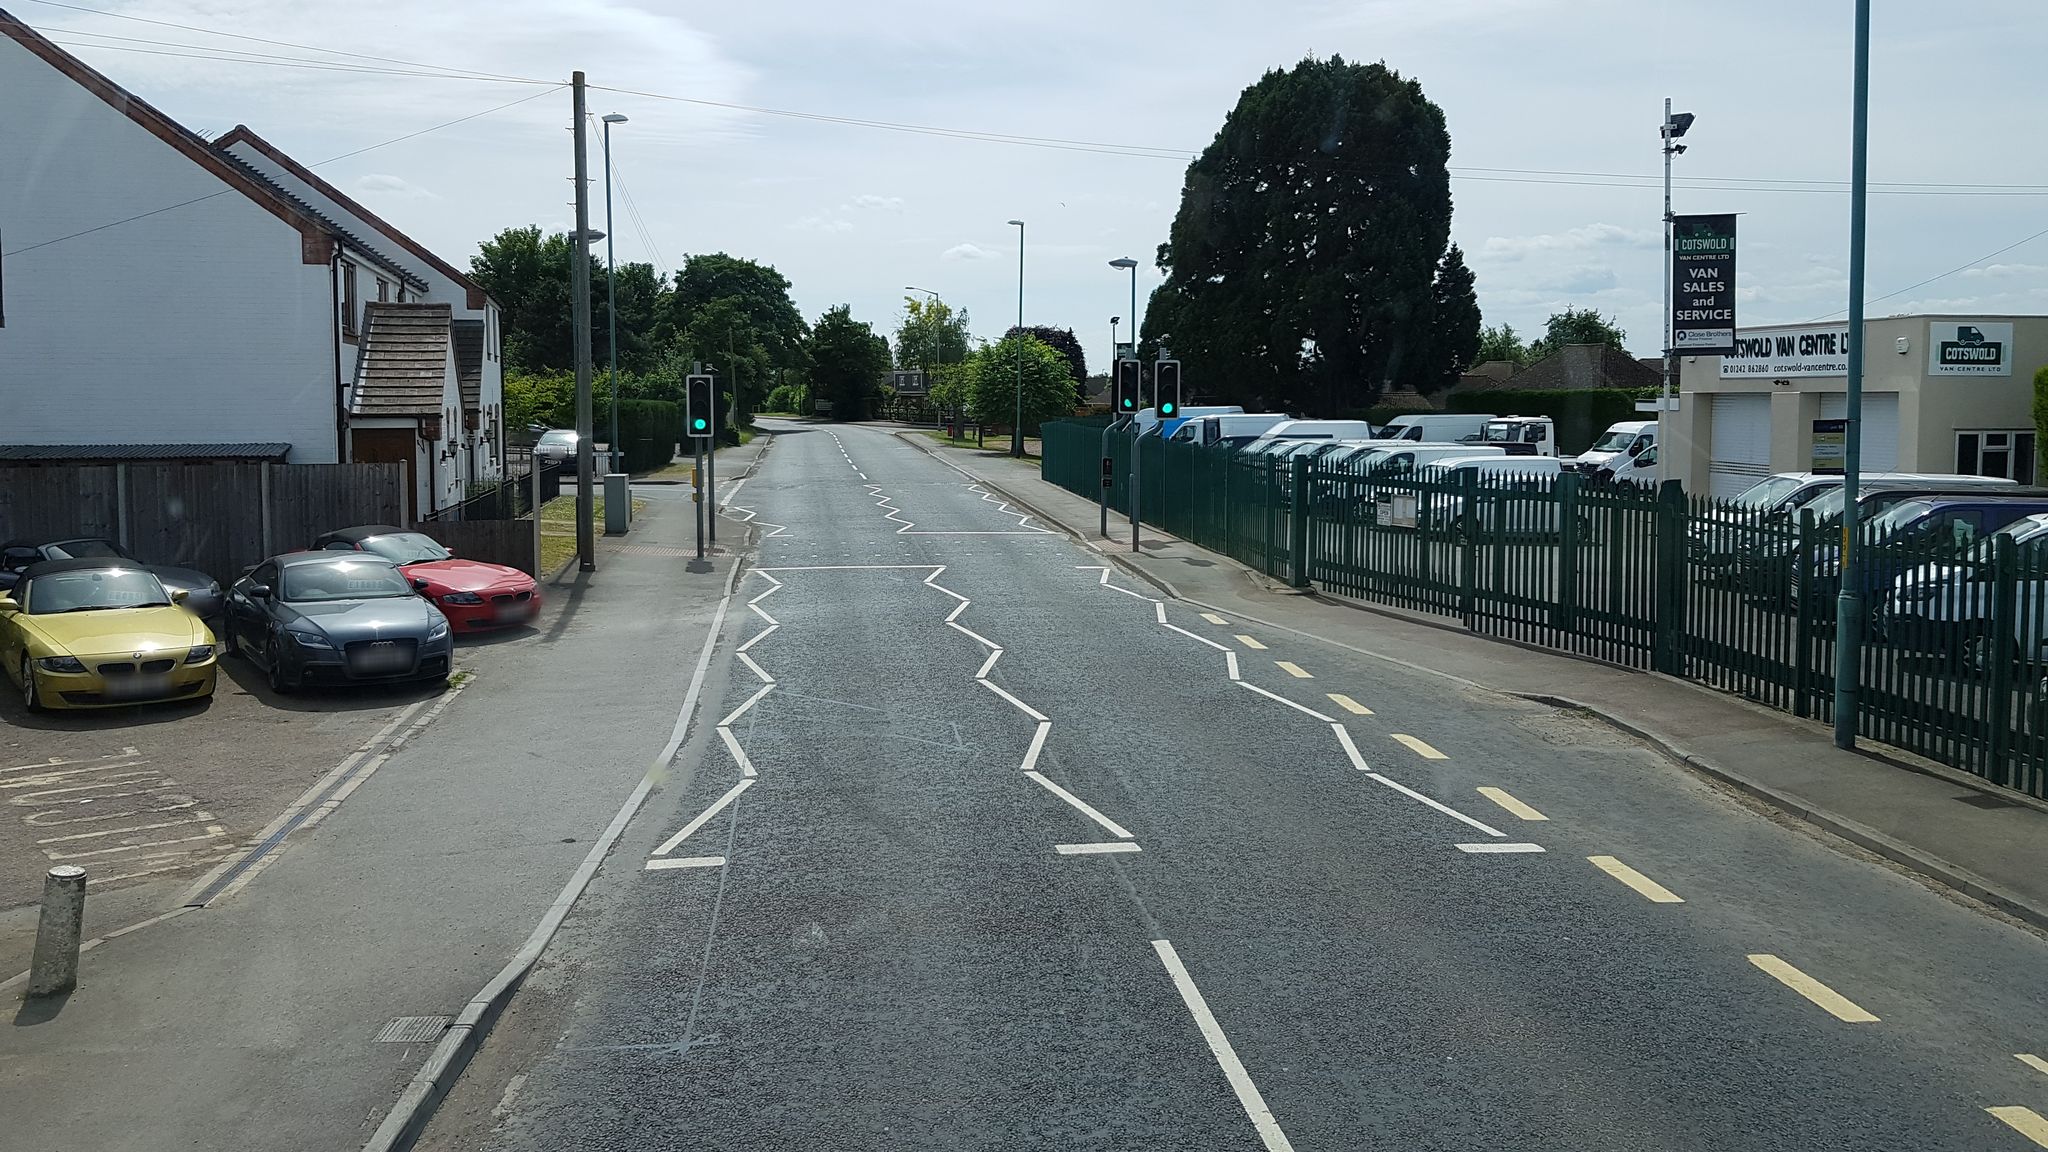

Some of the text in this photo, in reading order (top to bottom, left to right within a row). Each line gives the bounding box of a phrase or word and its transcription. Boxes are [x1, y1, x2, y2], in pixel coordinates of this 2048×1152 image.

[1682, 239, 1727, 250] COTSWOLD
[1689, 268, 1718, 279] VAN
[1683, 282, 1725, 293] SALES
[1692, 296, 1715, 306] and
[1676, 309, 1732, 320] SERVICE
[1724, 337, 1772, 359] TSWOLD
[1775, 336, 1795, 357] VAN
[1799, 334, 1837, 356] CENTRE
[1946, 347, 1996, 360] COTSWOLD
[1729, 365, 1746, 373] 01242
[1774, 363, 1848, 372] cotswold-vancentre.co.
